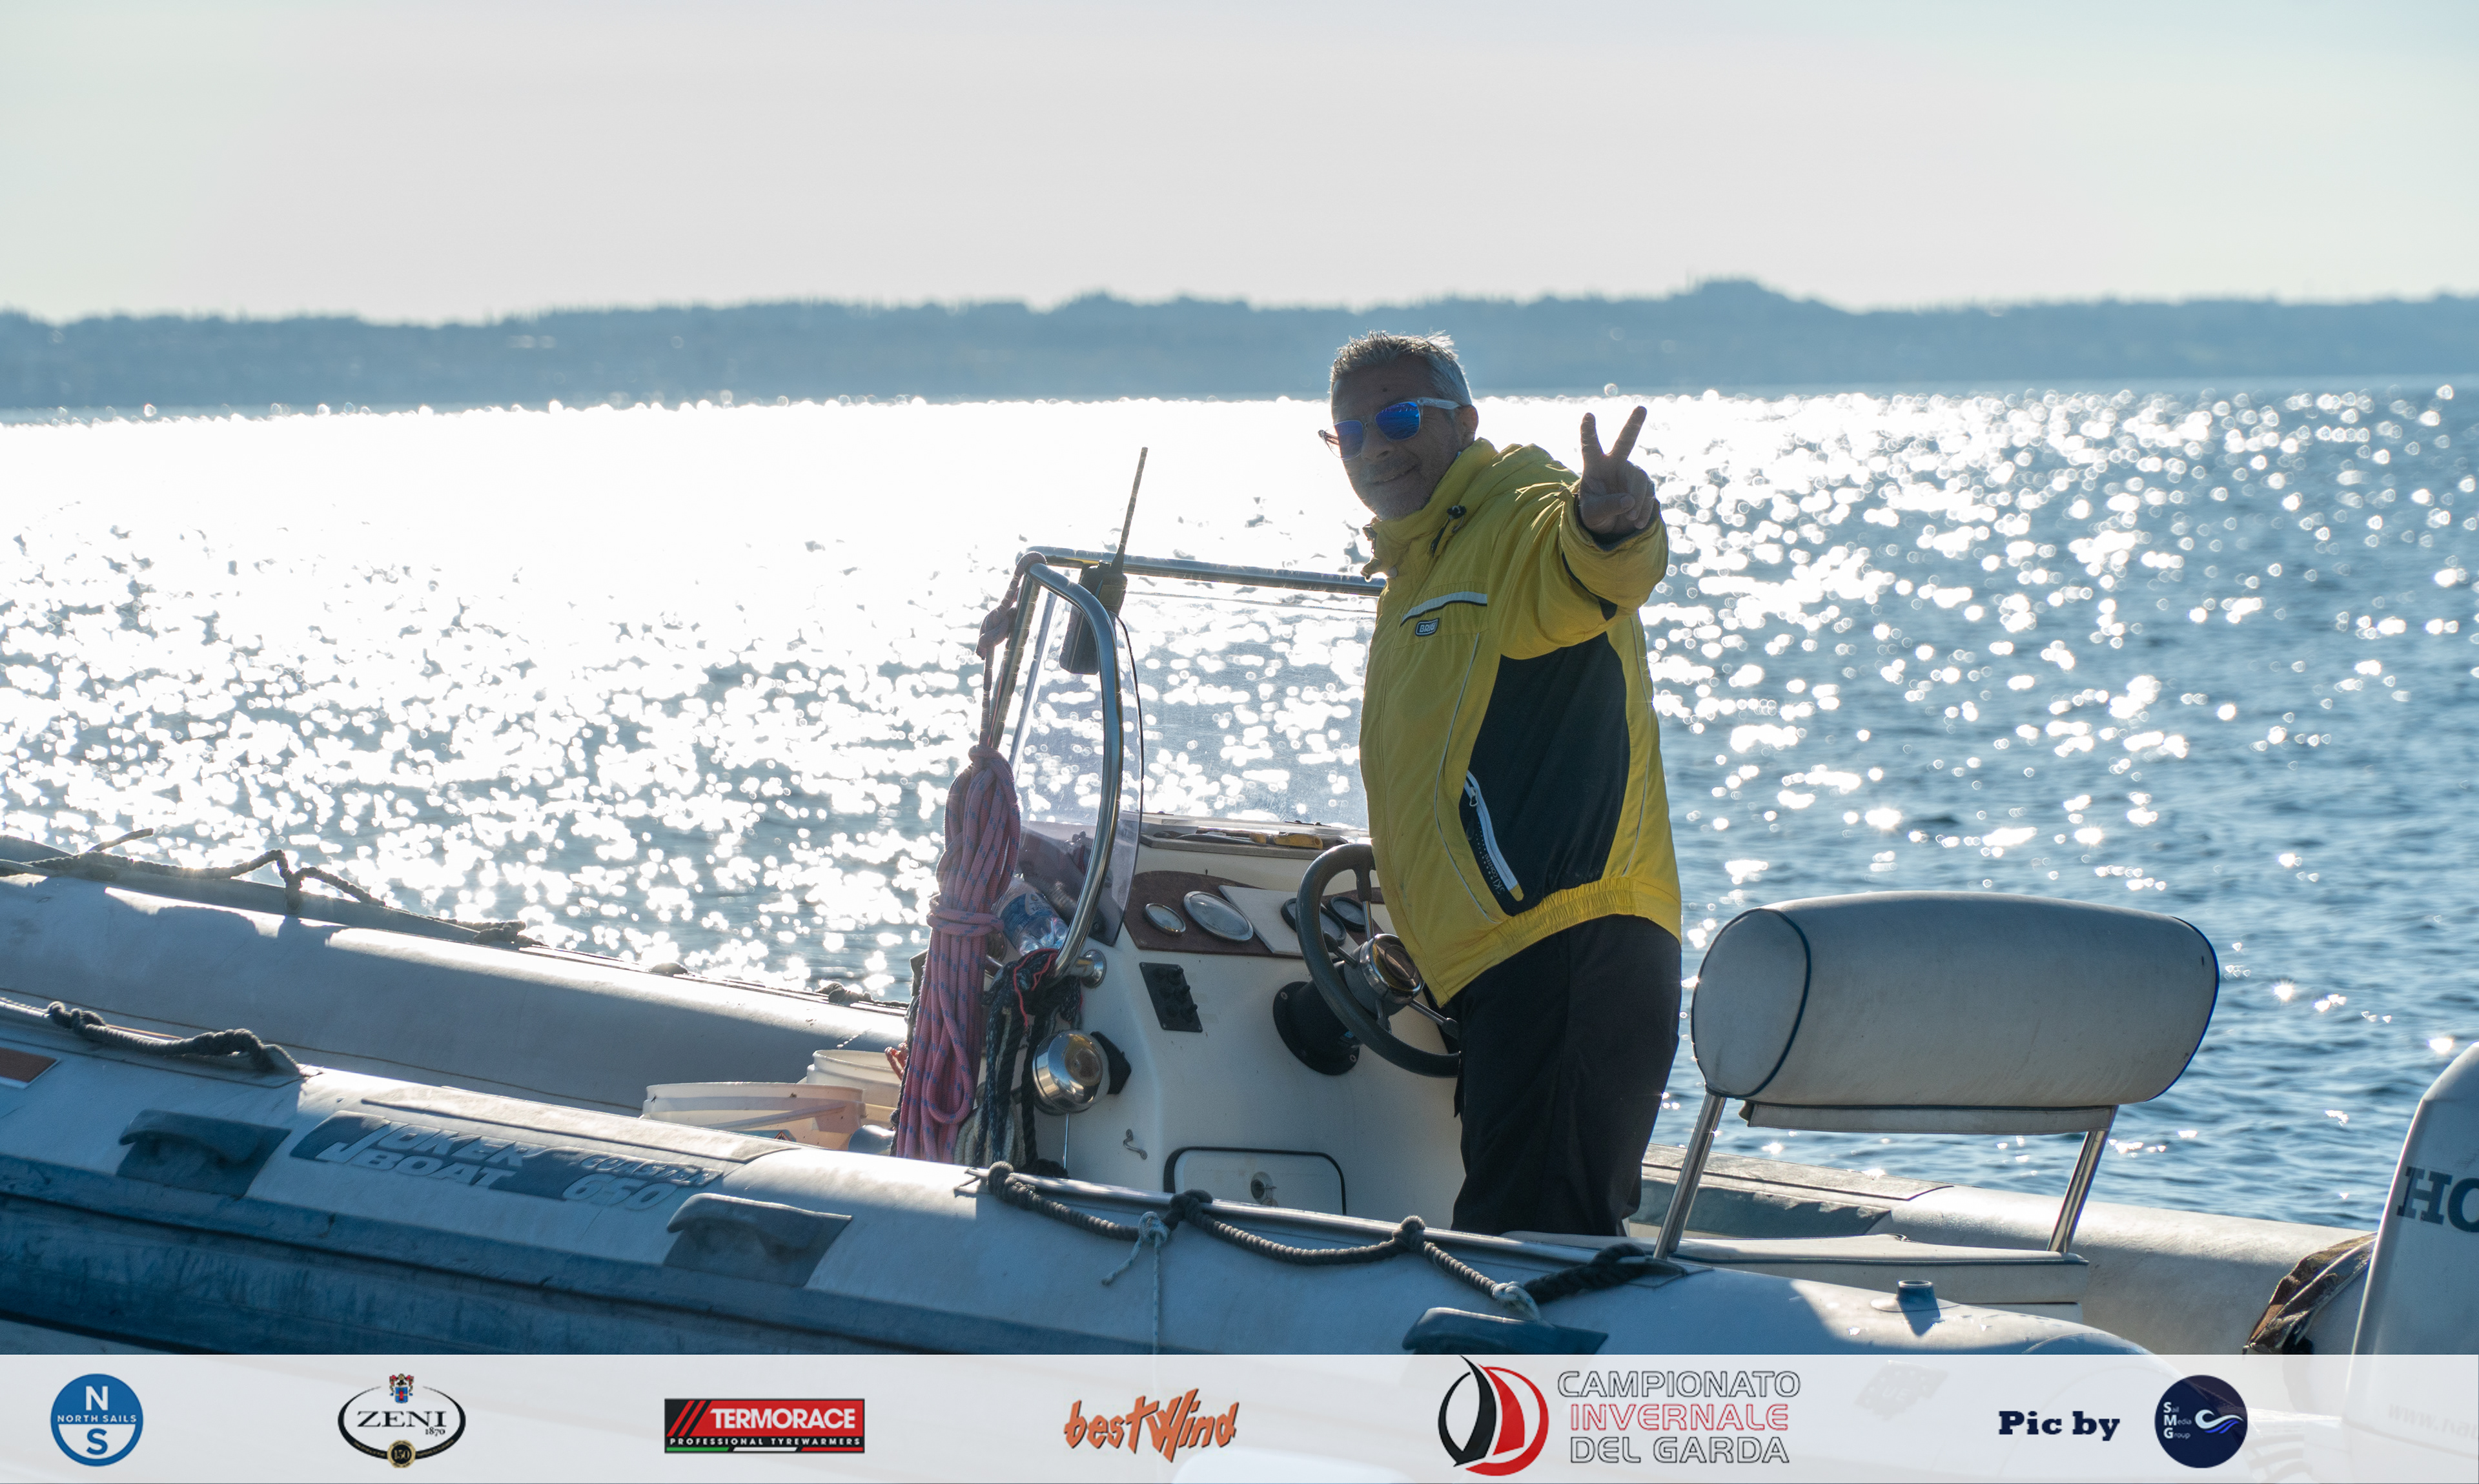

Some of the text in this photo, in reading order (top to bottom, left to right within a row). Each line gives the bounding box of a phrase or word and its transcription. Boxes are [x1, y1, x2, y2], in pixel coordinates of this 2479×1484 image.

[1484, 853, 1505, 894] SKI CONTEST
[315, 1122, 547, 1166] JOKER
[351, 1148, 517, 1189] BOAT
[562, 1173, 679, 1212] 650
